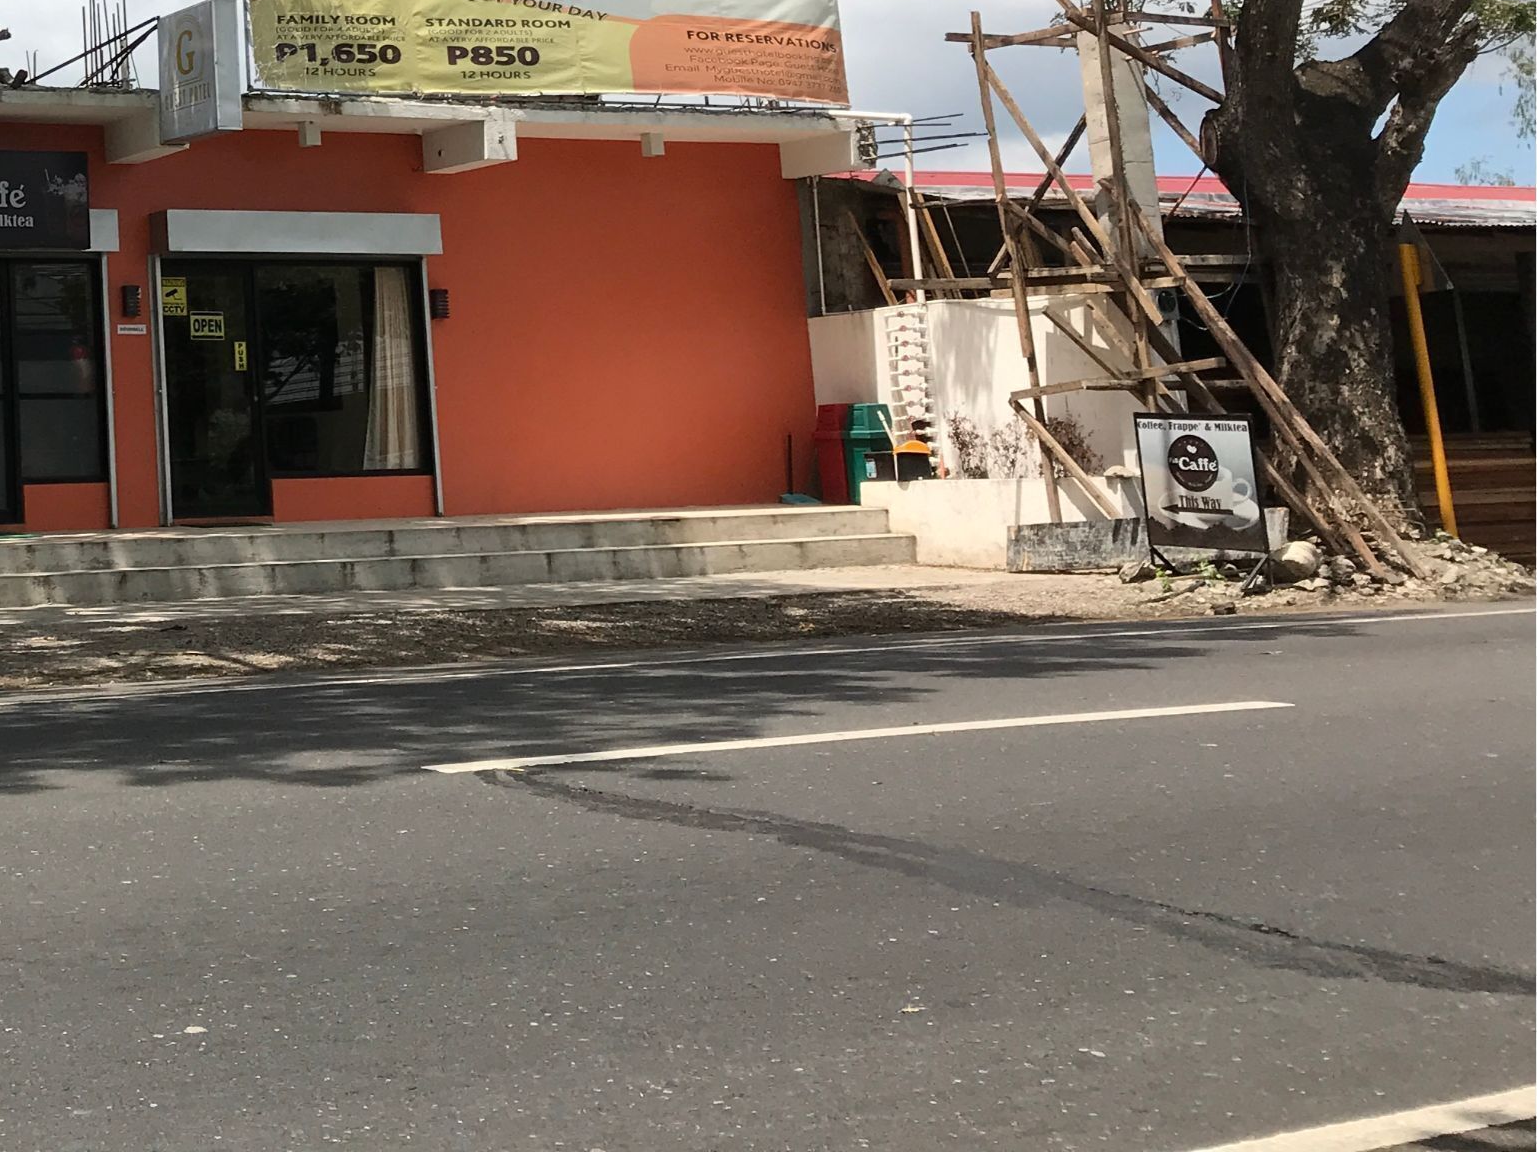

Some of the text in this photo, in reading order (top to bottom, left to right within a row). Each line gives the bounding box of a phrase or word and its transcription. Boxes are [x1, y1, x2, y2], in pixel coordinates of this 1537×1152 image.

[277, 15, 396, 26] FAMILY ROOM
[568, 6, 608, 21] DAY
[425, 18, 571, 29] STANDARD ROOM
[686, 30, 837, 53] FOR RESERVATIONS
[176, 30, 195, 75] G
[447, 45, 540, 67] P850
[305, 67, 376, 77] 12 HOURS
[461, 70, 531, 80] 12 HOURS
[192, 318, 222, 333] OPEN
[1204, 423, 1212, 431] &
[1214, 423, 1248, 432] Milktea
[1178, 456, 1218, 471] Caffé
[1179, 495, 1221, 509] This Way
